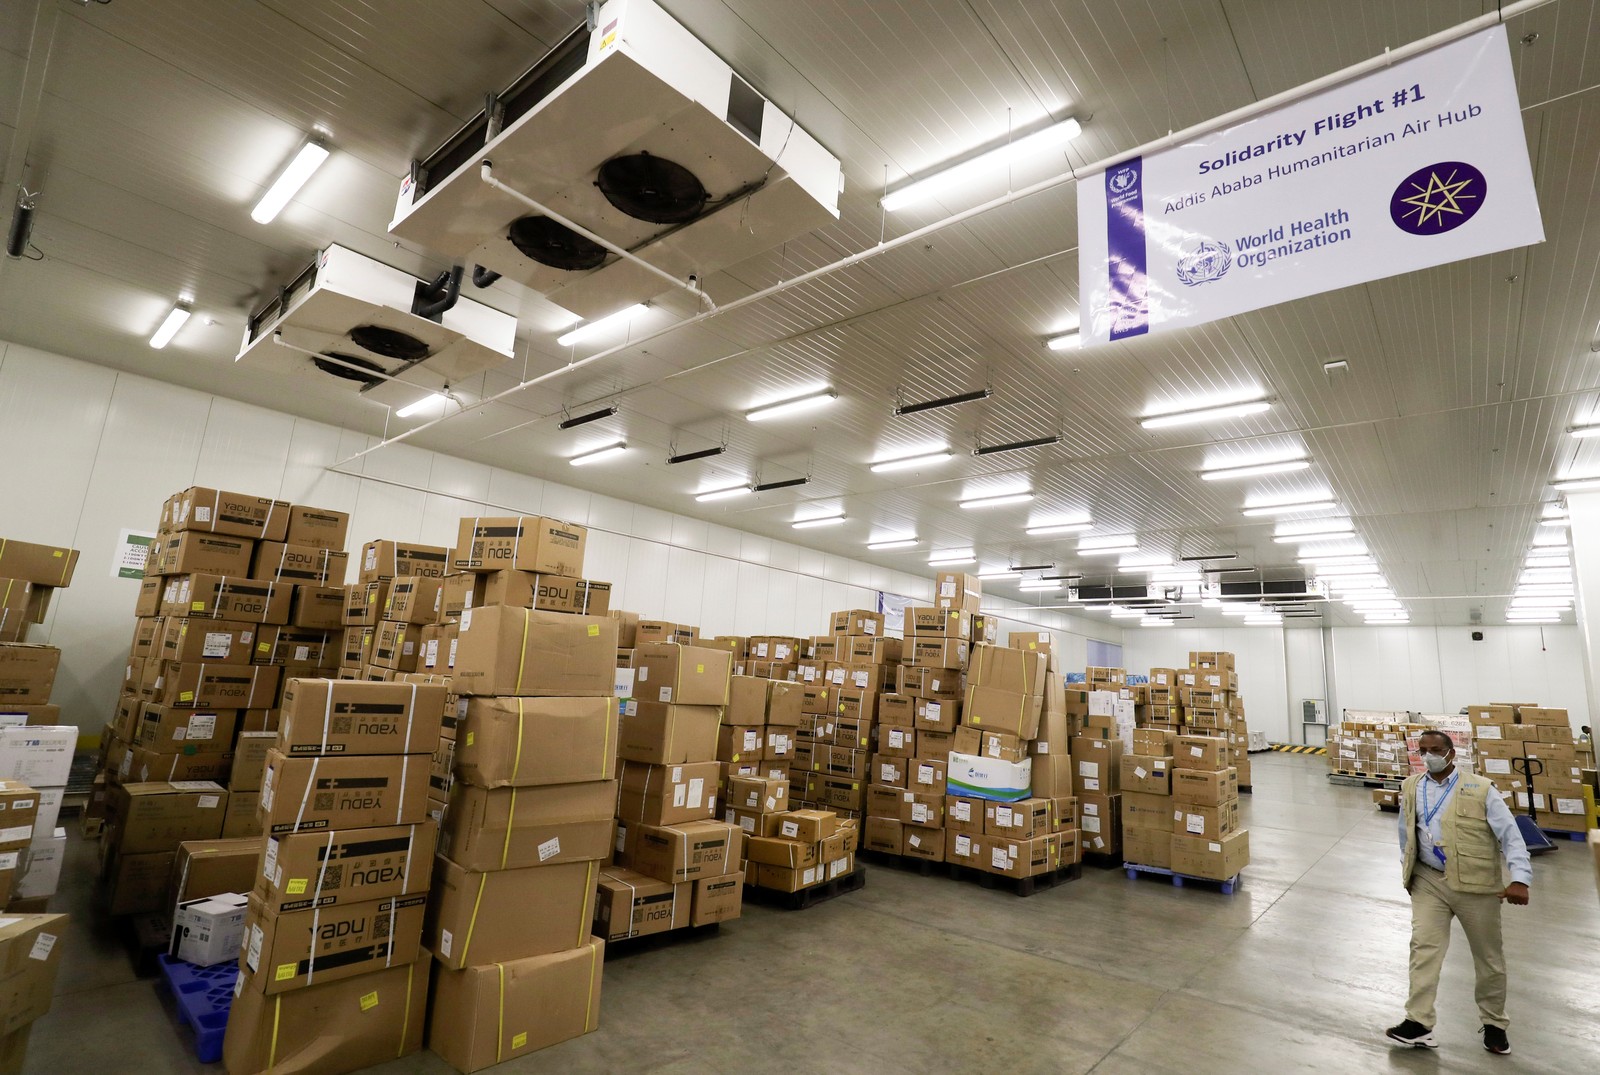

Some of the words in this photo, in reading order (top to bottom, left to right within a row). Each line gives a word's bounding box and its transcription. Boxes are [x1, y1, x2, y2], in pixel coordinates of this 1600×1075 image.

[1199, 128, 1306, 175] Solidarity
[1314, 99, 1385, 137] Flight
[1391, 83, 1426, 108] #1
[1164, 190, 1206, 215] Addis
[1211, 174, 1263, 199] Ababa
[1268, 132, 1396, 180] Humanitarian
[1402, 118, 1431, 140] Air
[1438, 102, 1483, 127] Hub
[1111, 193, 1125, 203] World
[1125, 189, 1138, 198] Food
[1235, 225, 1285, 253] World
[1290, 209, 1350, 238] Health
[1236, 227, 1351, 270] Organization
